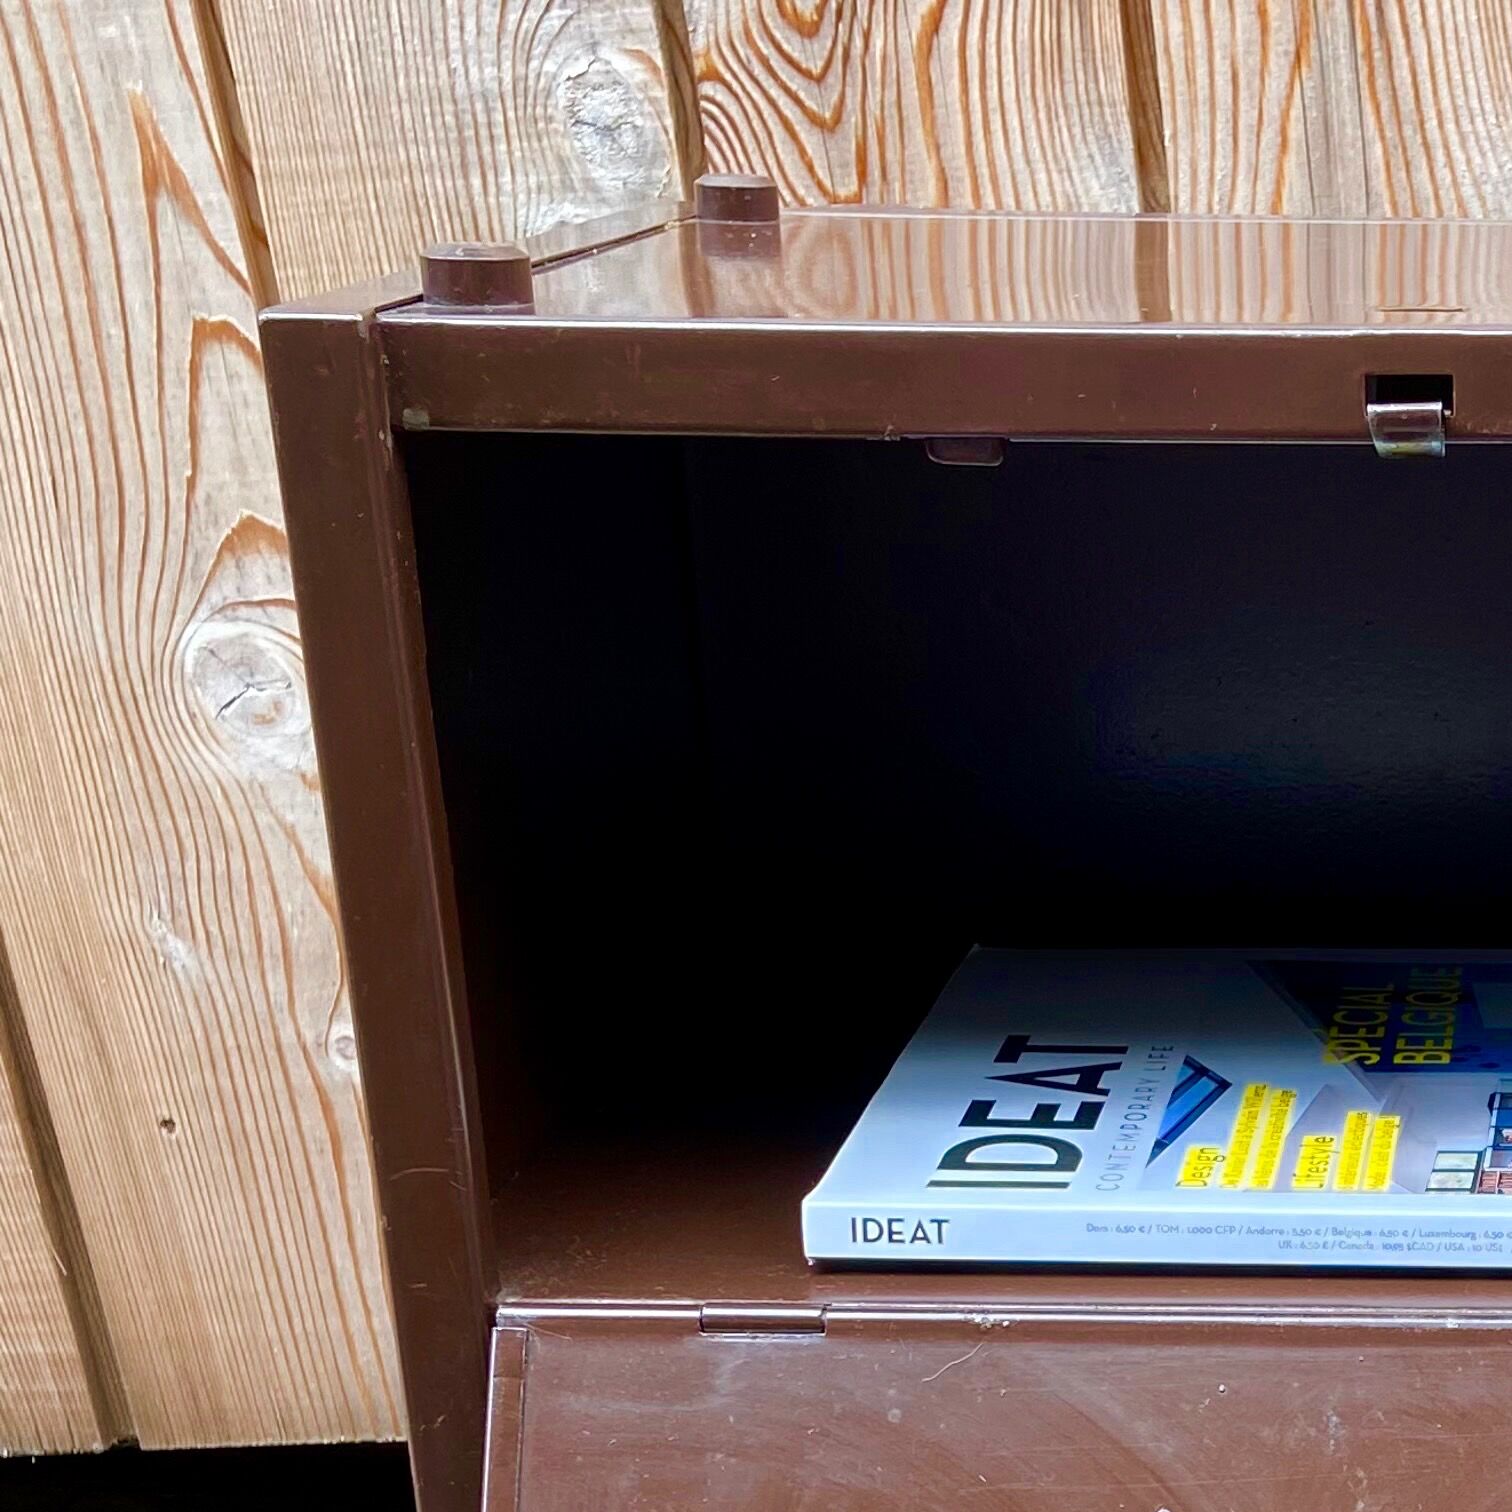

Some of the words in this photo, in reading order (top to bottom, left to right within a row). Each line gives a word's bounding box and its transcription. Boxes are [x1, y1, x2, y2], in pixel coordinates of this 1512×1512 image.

[1319, 982, 1394, 1065] SPÉCIAL
[1391, 966, 1464, 1064] BELGIQUE
[926, 1034, 1131, 1189] IDEAT
[1095, 1077, 1161, 1190] CONTEMPORARY
[1146, 1044, 1175, 1070] LIFE
[1176, 1147, 1226, 1188] Design
[1291, 1136, 1341, 1189] Lifestyle
[851, 1217, 950, 1244] IDEAT
[1156, 1224, 1179, 1234] TOM
[1215, 1225, 1236, 1234] CFP
[1246, 1226, 1285, 1235] Andorre
[1332, 1227, 1372, 1239] Belgique
[1419, 1228, 1476, 1240] Luxembourg
[1338, 1241, 1374, 1250] Canada
[1444, 1243, 1464, 1251] USA
